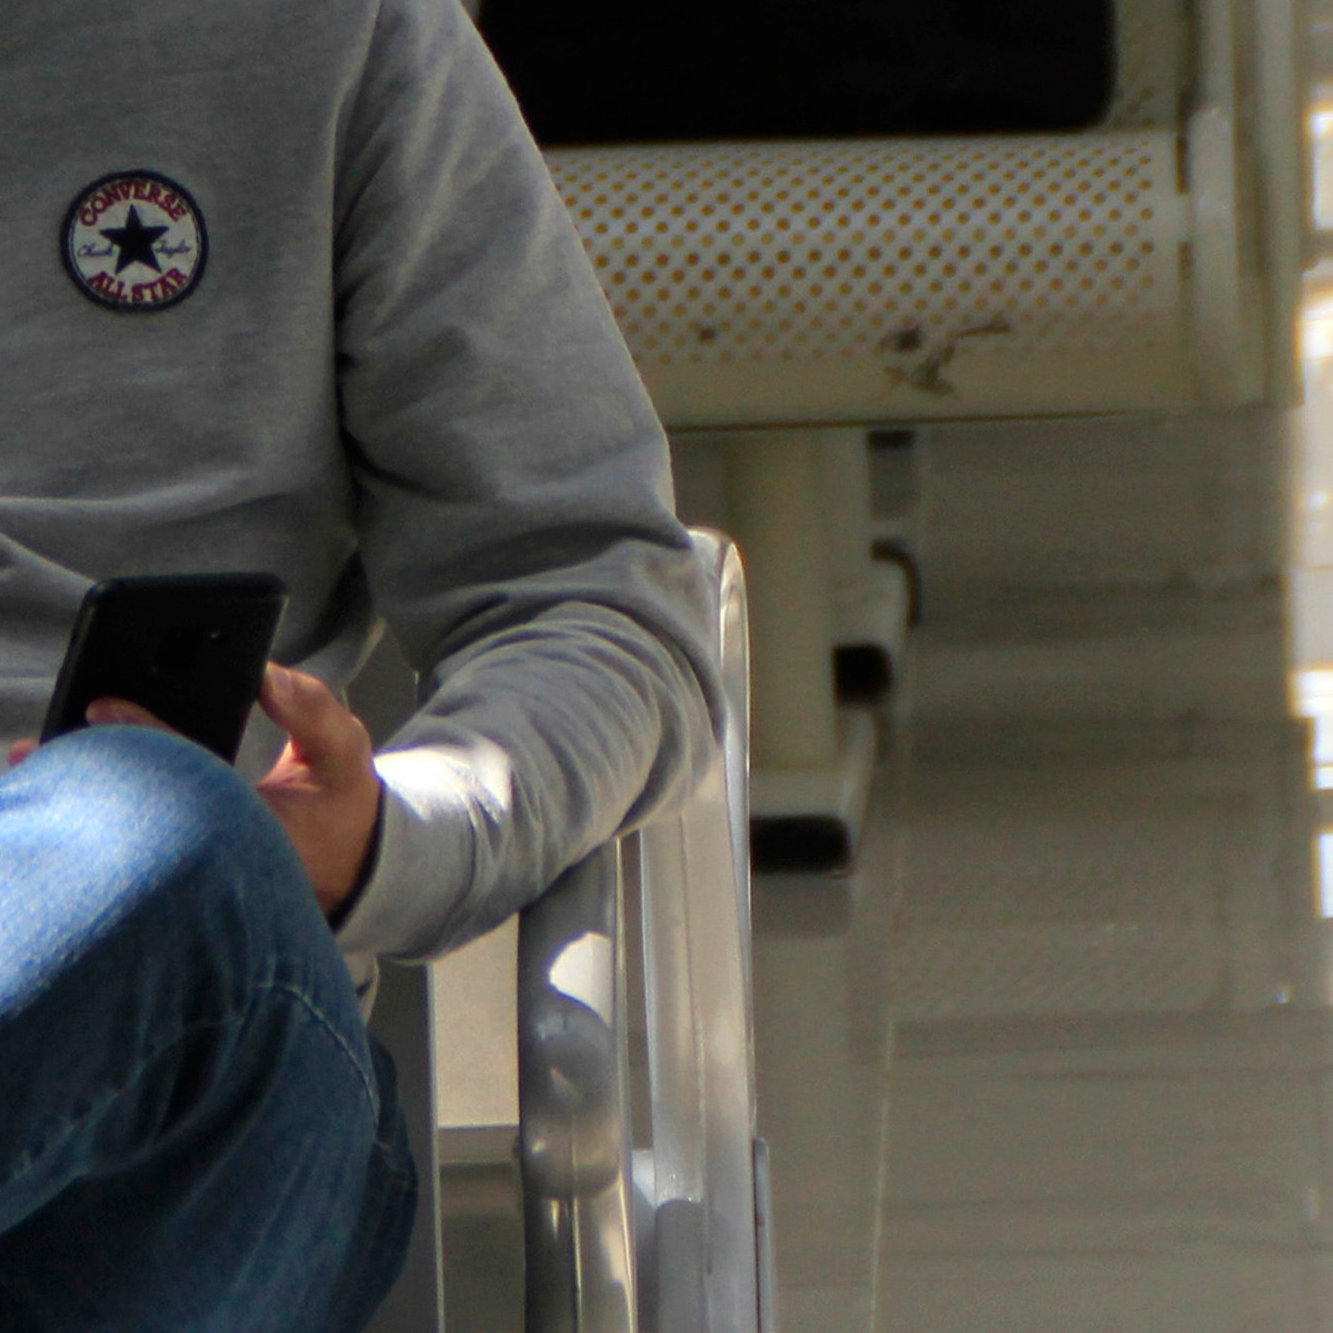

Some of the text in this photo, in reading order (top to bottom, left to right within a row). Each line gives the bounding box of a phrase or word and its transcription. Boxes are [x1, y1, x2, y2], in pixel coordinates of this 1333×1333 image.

[79, 181, 188, 227] CONVERSE
[88, 267, 188, 302] ALL STAR
